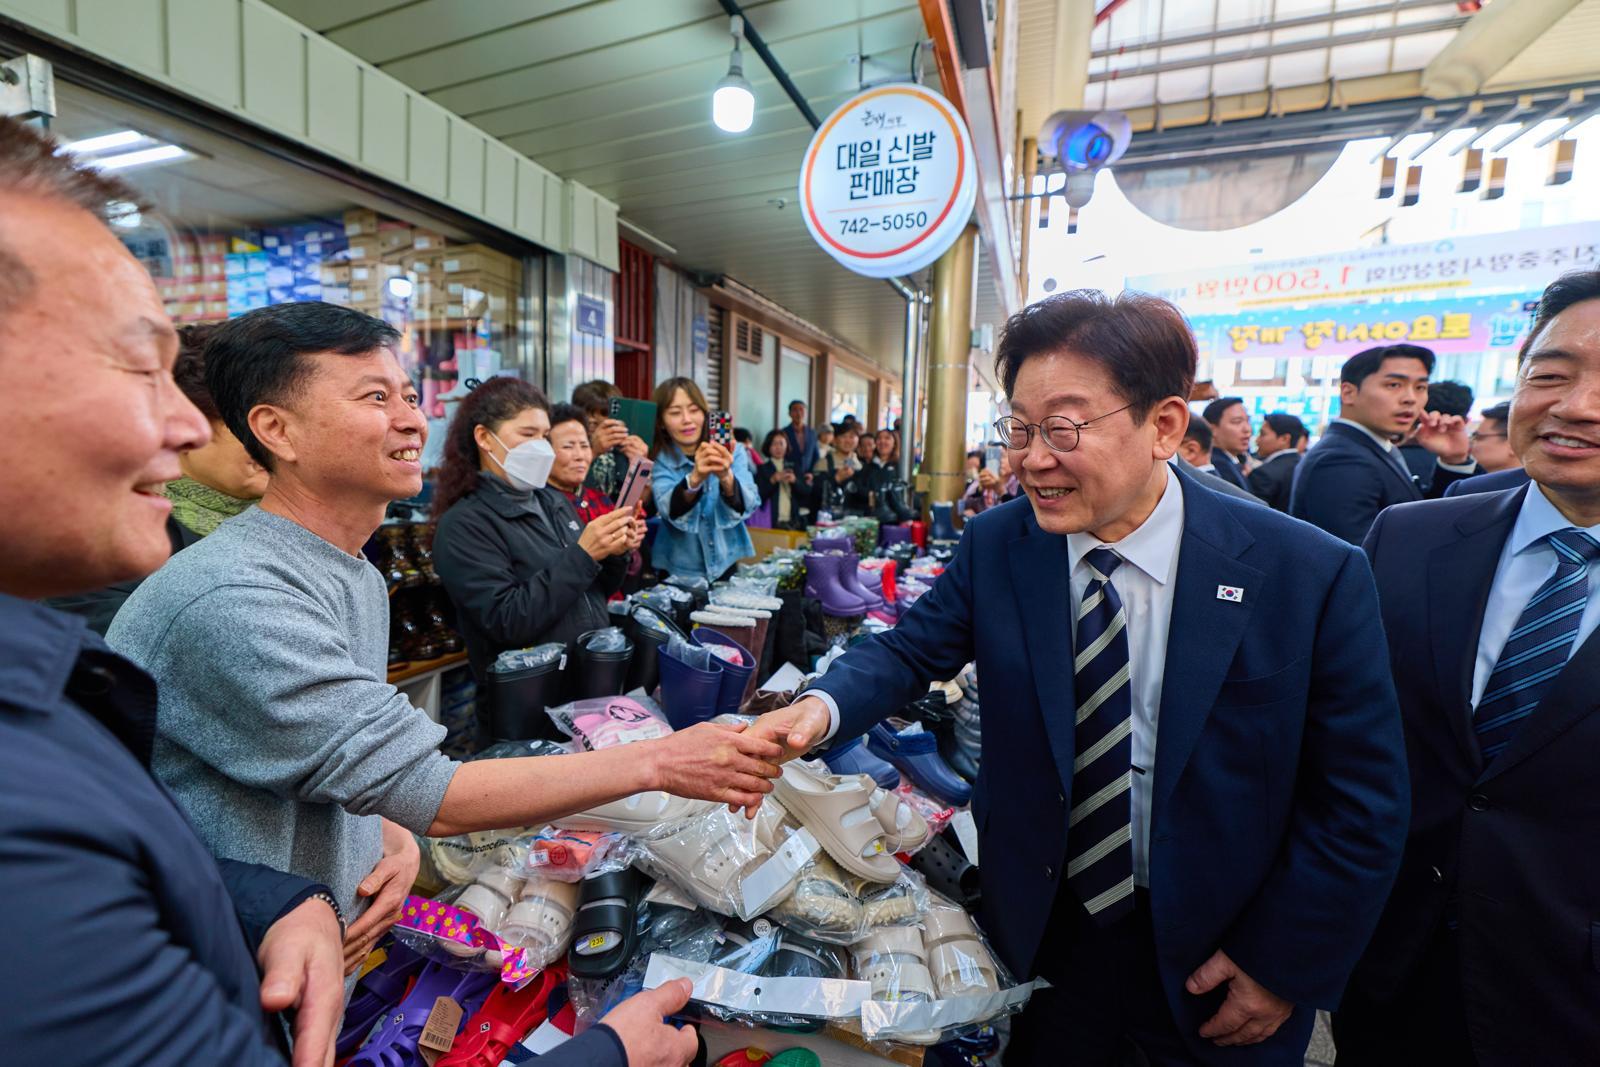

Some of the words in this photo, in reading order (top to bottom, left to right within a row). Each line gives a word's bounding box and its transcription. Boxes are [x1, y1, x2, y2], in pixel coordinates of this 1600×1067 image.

[836, 138, 881, 170] 대일
[888, 130, 936, 164] 신발
[849, 166, 919, 201] 판매장
[839, 211, 928, 235] 742-5050
[587, 310, 597, 327] 4
